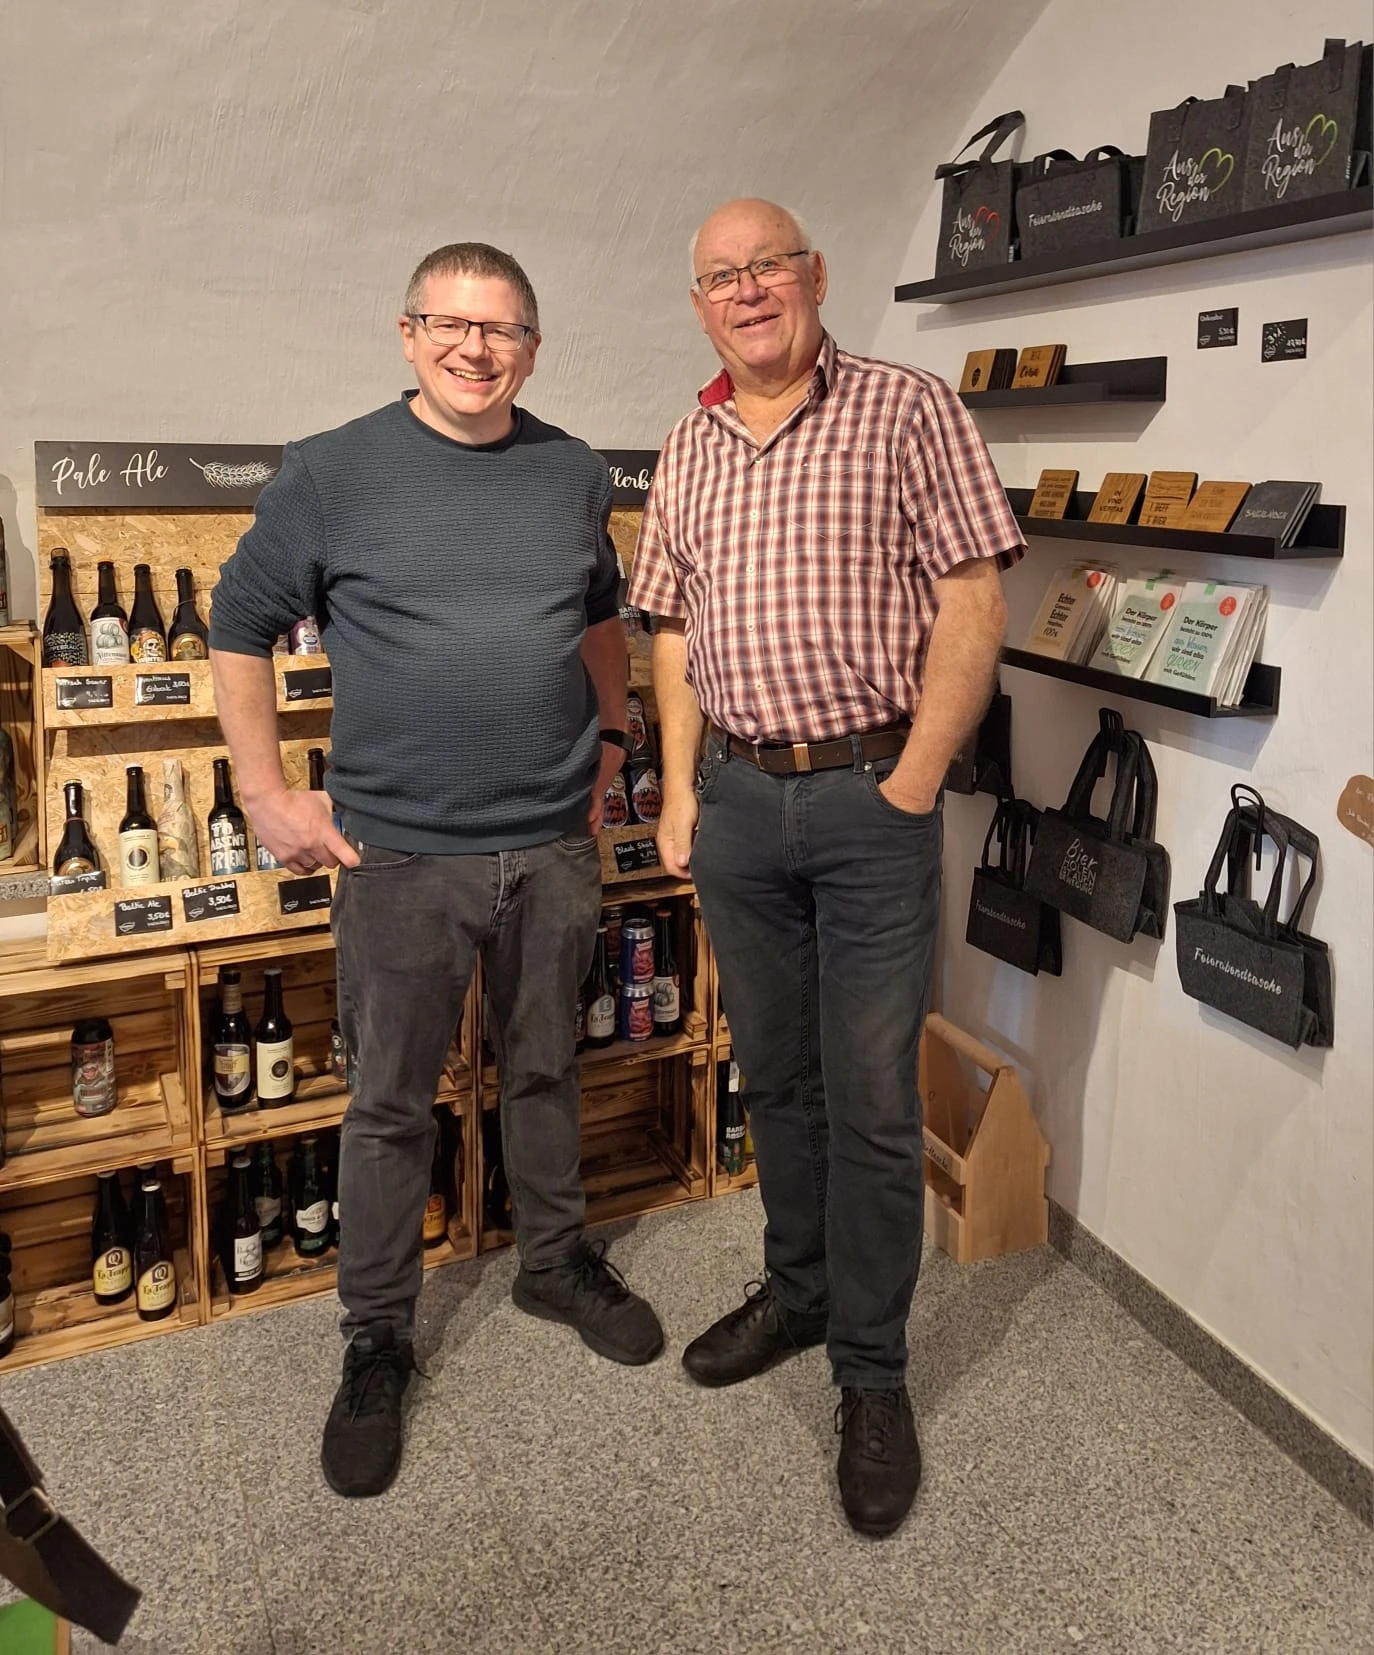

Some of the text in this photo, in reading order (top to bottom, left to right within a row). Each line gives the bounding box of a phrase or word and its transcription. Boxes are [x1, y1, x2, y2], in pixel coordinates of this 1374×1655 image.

[1266, 118, 1301, 155] Aus
[1163, 150, 1196, 182] Aus
[1262, 154, 1315, 198] Region
[1156, 182, 1210, 222] Region
[952, 208, 972, 234] Aus
[949, 233, 985, 267] Region
[52, 449, 168, 494] Pale Ale
[609, 466, 654, 490] llerbi
[1125, 607, 1137, 616] Der
[1184, 616, 1218, 631] Der Körper
[211, 821, 234, 838] TO
[211, 833, 246, 851] ABSENT
[1067, 838, 1098, 868] Bier
[1062, 856, 1096, 881] HOLEN
[1194, 946, 1282, 995] Feierabendtasche
